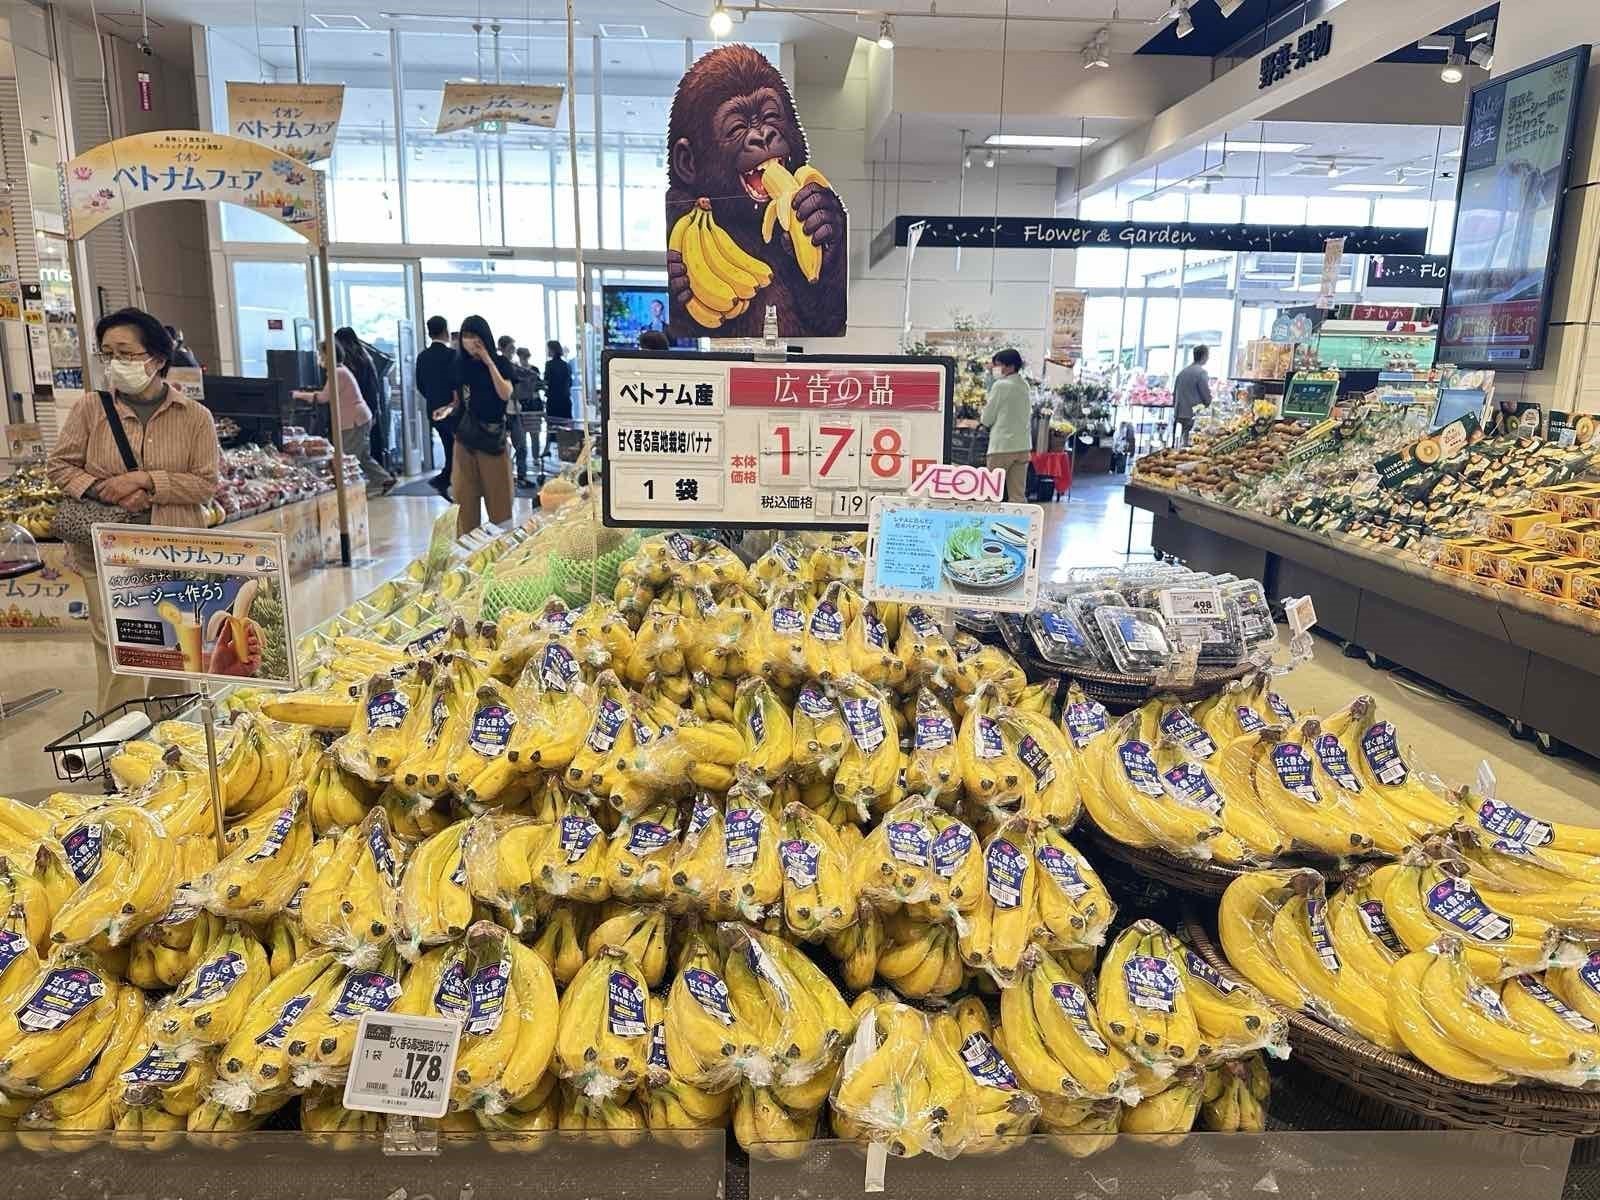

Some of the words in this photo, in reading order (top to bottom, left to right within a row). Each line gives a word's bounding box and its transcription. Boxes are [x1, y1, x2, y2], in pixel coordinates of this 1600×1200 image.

[1259, 20, 1333, 89] 野菜・果物
[272, 106, 303, 119] イオン
[236, 119, 335, 139] ベトナムフェア
[176, 152, 201, 162] イオン
[112, 165, 263, 192] ベトナムフェア
[1024, 224, 1092, 243] Flower
[1097, 227, 1111, 243] &
[1119, 226, 1197, 245] Garden
[1364, 306, 1404, 320] すいか
[620, 382, 715, 407] ベトナム産
[773, 373, 896, 404] 広告の品
[617, 429, 713, 454] 甘く香る高地栽培バナナ
[730, 455, 758, 469] 本体
[773, 427, 902, 479] 178
[730, 470, 758, 485] 価格
[911, 467, 1003, 498] AEON
[643, 479, 655, 500] 1
[675, 478, 699, 502] 袋
[761, 495, 814, 510] 税込価格
[113, 583, 224, 609] スムージーを作ろう
[1193, 600, 1212, 609] 498
[478, 717, 505, 727] 甘く香る
[1364, 732, 1390, 749] 甘く香る
[1123, 751, 1150, 764] 甘く香る
[1276, 756, 1305, 767] 甘く香る
[1485, 809, 1506, 831] 甘く香る
[934, 837, 963, 855] 甘く香る
[990, 847, 1018, 868] 甘く香る
[1434, 892, 1466, 915] 甘く香る
[51, 976, 88, 995] 甘く香る
[350, 982, 385, 1000] 甘く香る
[609, 983, 637, 1001] 甘く香る
[404, 1052, 442, 1082] 178
